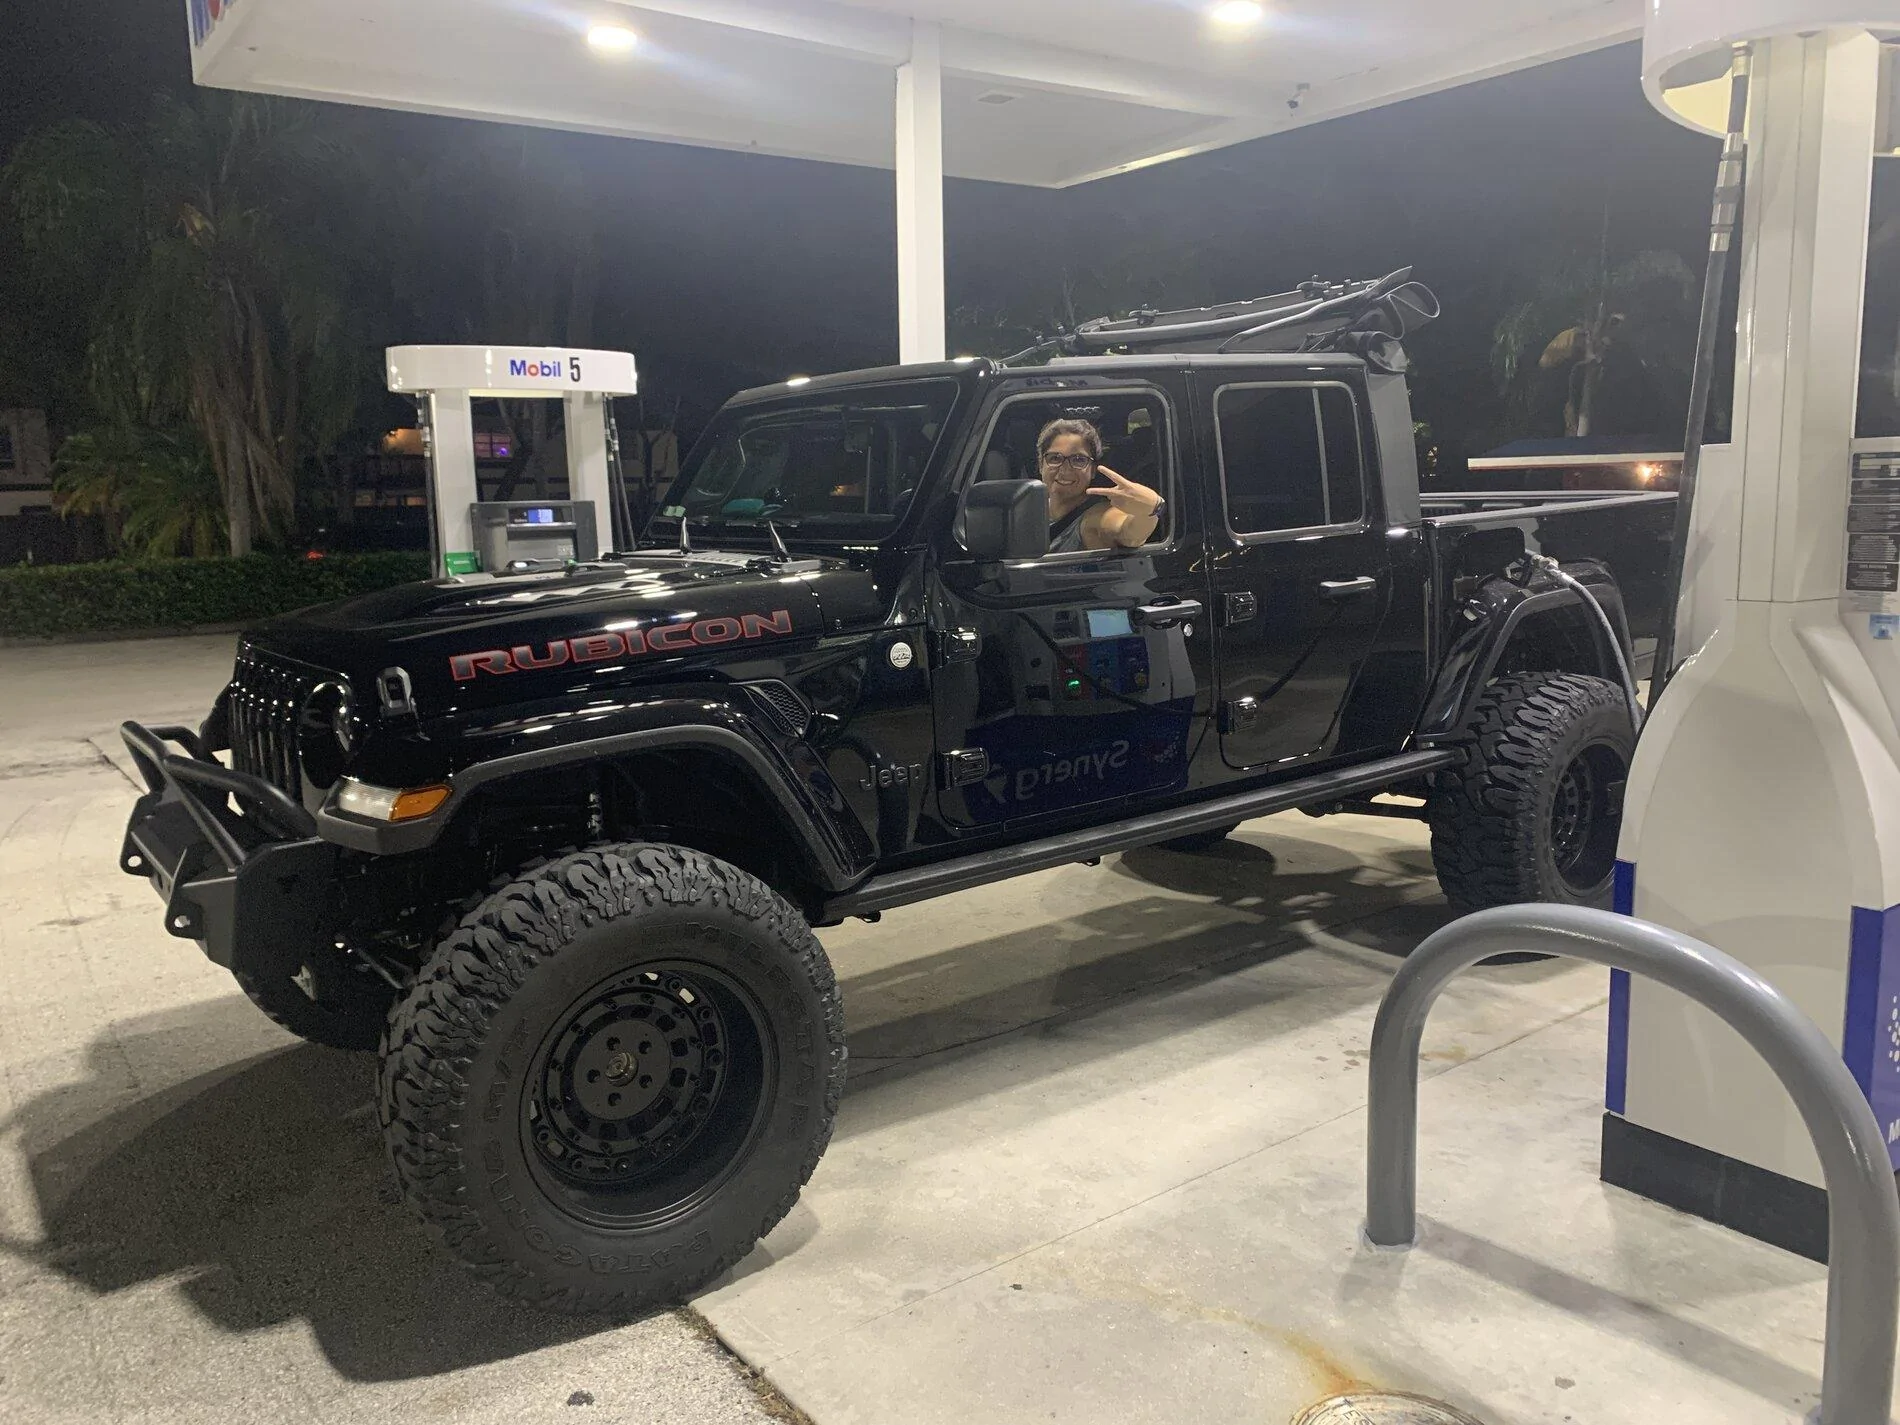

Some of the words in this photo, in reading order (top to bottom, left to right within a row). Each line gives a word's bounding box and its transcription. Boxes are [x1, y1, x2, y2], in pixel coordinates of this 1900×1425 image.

[510, 359, 561, 377] Mobil
[569, 356, 581, 382] 5
[450, 609, 792, 681] RUBICON
[859, 763, 921, 791] Jeep
